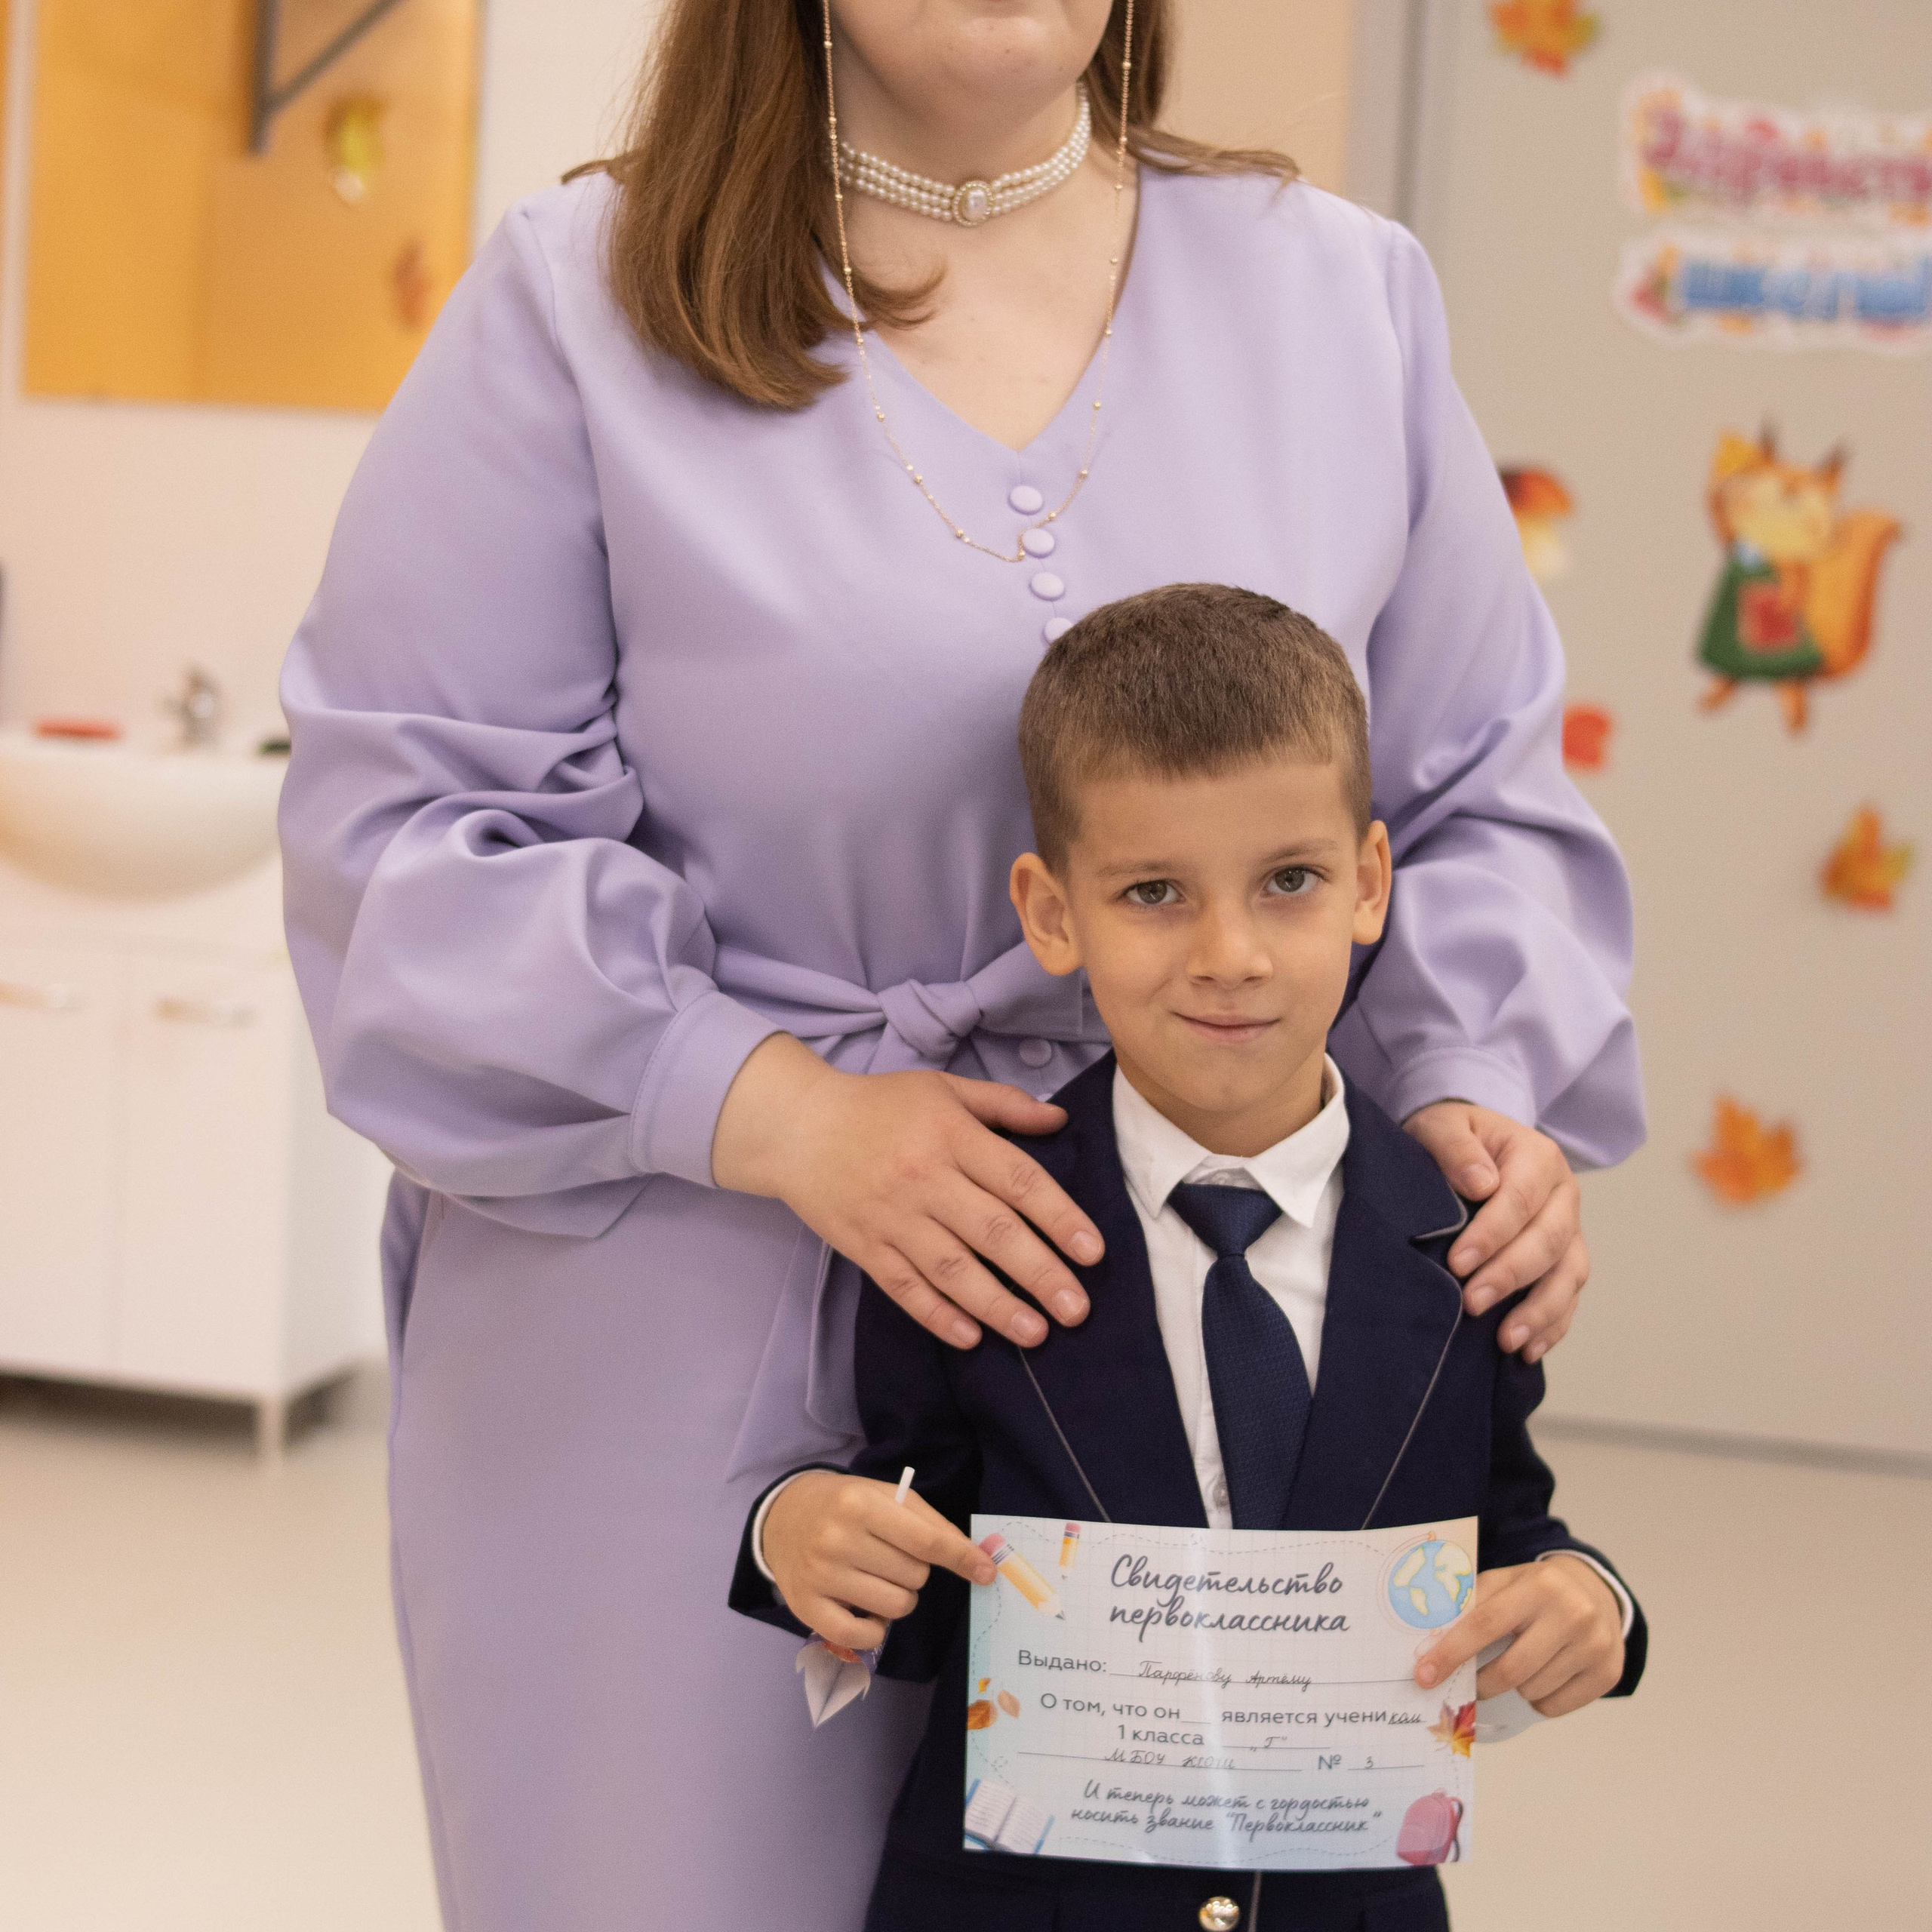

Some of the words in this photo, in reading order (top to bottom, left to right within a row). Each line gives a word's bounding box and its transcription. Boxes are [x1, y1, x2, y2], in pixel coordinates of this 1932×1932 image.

[1111, 1554, 1343, 1607] Свидетельство
[1110, 1595, 1349, 1642] первоклассника
[1018, 1650, 1106, 1672] Выдано:
[1041, 1693, 1057, 1709] О
[1063, 1698, 1106, 1716] том,
[1112, 1703, 1147, 1717] что
[1154, 1706, 1180, 1719] он
[1222, 1711, 1318, 1725] является
[1117, 1724, 1126, 1740] 1
[1132, 1729, 1205, 1746] класса
[1318, 1754, 1341, 1770] №
[1364, 1756, 1374, 1769] 3
[1084, 1780, 1101, 1799] И
[1106, 1786, 1174, 1811] теперь
[1180, 1793, 1250, 1810] может
[1255, 1798, 1266, 1810] с
[1269, 1795, 1370, 1820] гордостью
[1071, 1806, 1139, 1824] носить
[1146, 1810, 1214, 1832] звание
